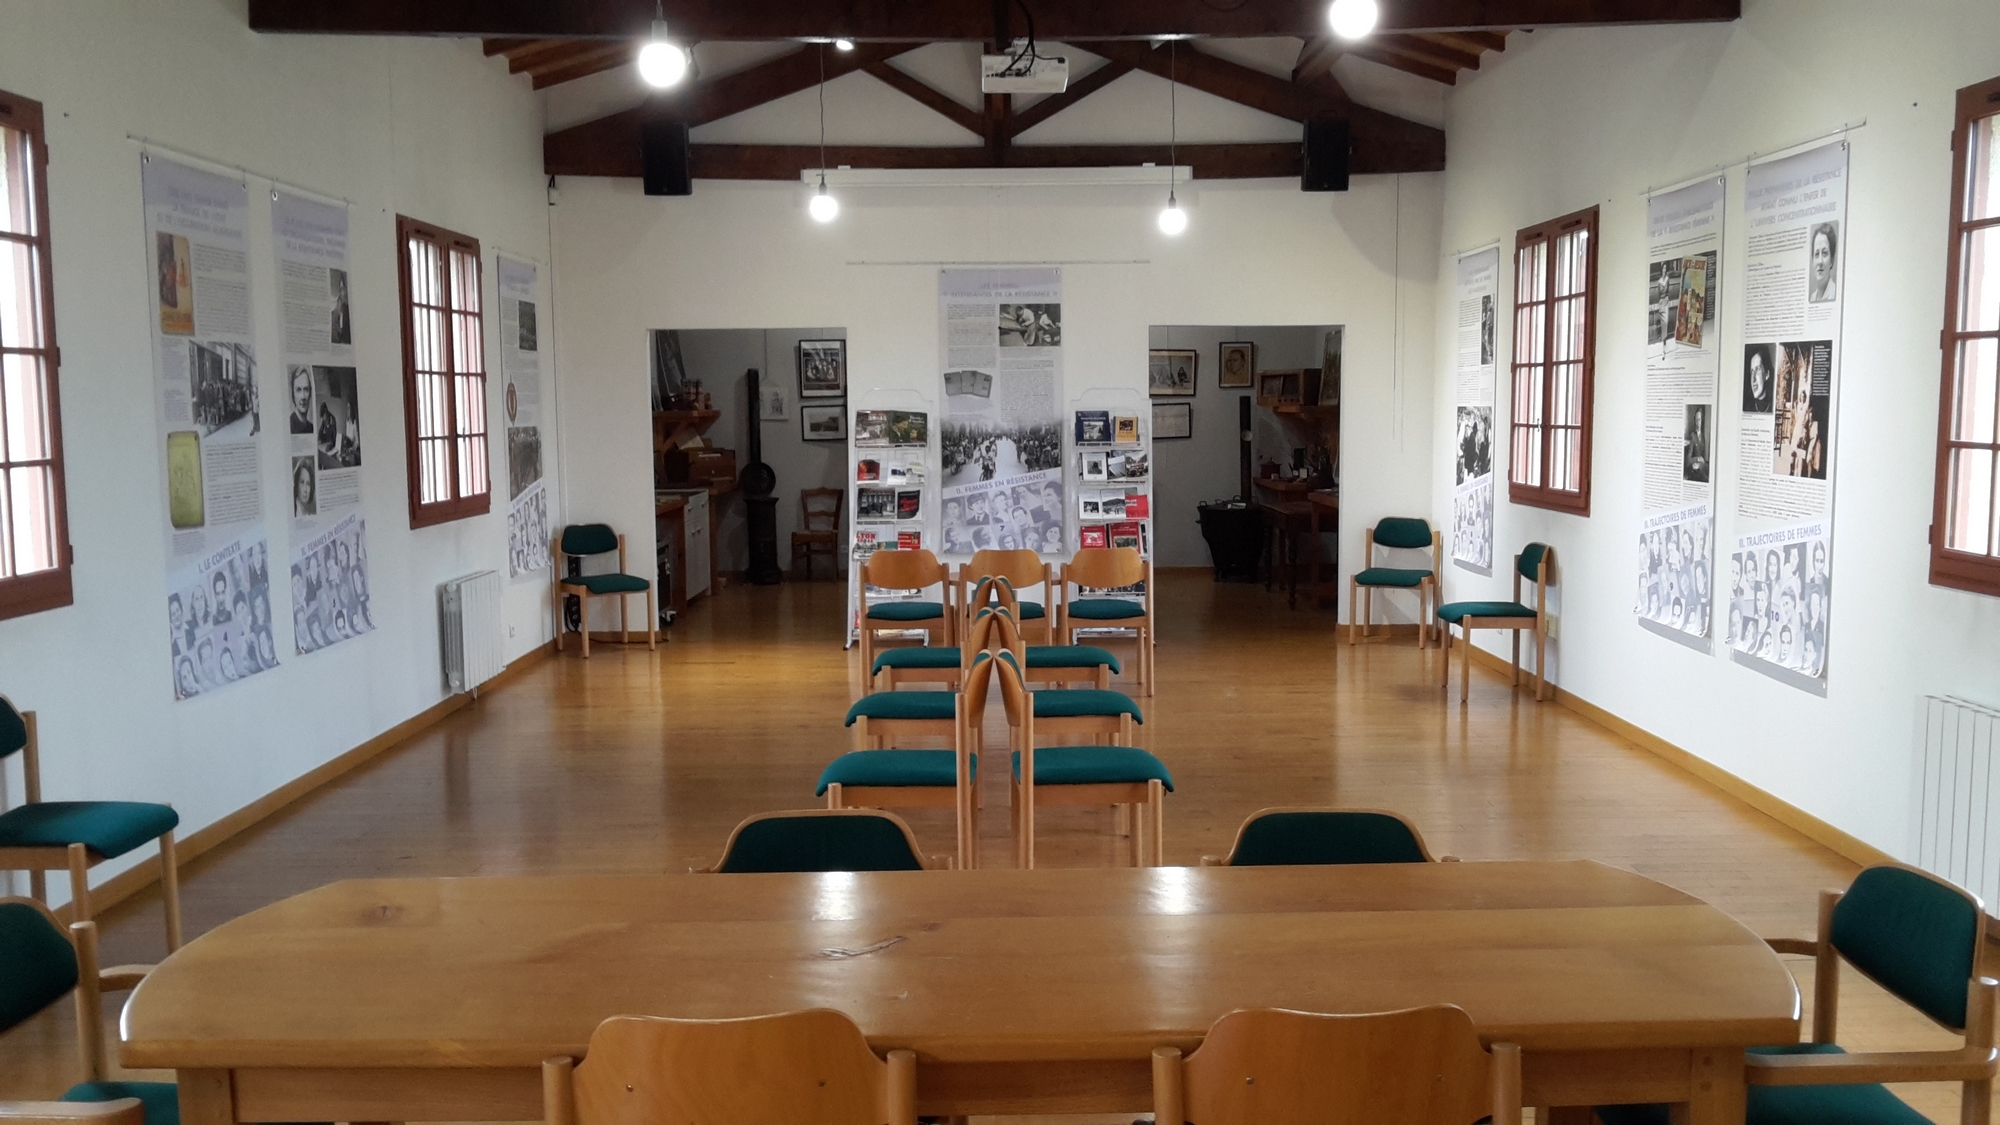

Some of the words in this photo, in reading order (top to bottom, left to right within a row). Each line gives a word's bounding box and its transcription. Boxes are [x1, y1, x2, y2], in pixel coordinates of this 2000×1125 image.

[1777, 196, 1798, 207] CONNU
[964, 482, 994, 493] FEMMES
[994, 480, 1005, 488] EN
[1006, 472, 1047, 486] RÉSISTANCE
[1650, 512, 1680, 528] TRAJECTOIRES
[1680, 510, 1687, 520] DE
[1687, 505, 1707, 519] FEMMES
[1746, 530, 1786, 547] TRAJECTOIRES
[1787, 529, 1795, 540] DE
[1796, 524, 1822, 539] FEMMES
[203, 558, 211, 571] LE
[211, 540, 241, 566] CONTEXTE
[1669, 582, 1674, 591] 9
[1771, 610, 1780, 622] 10
